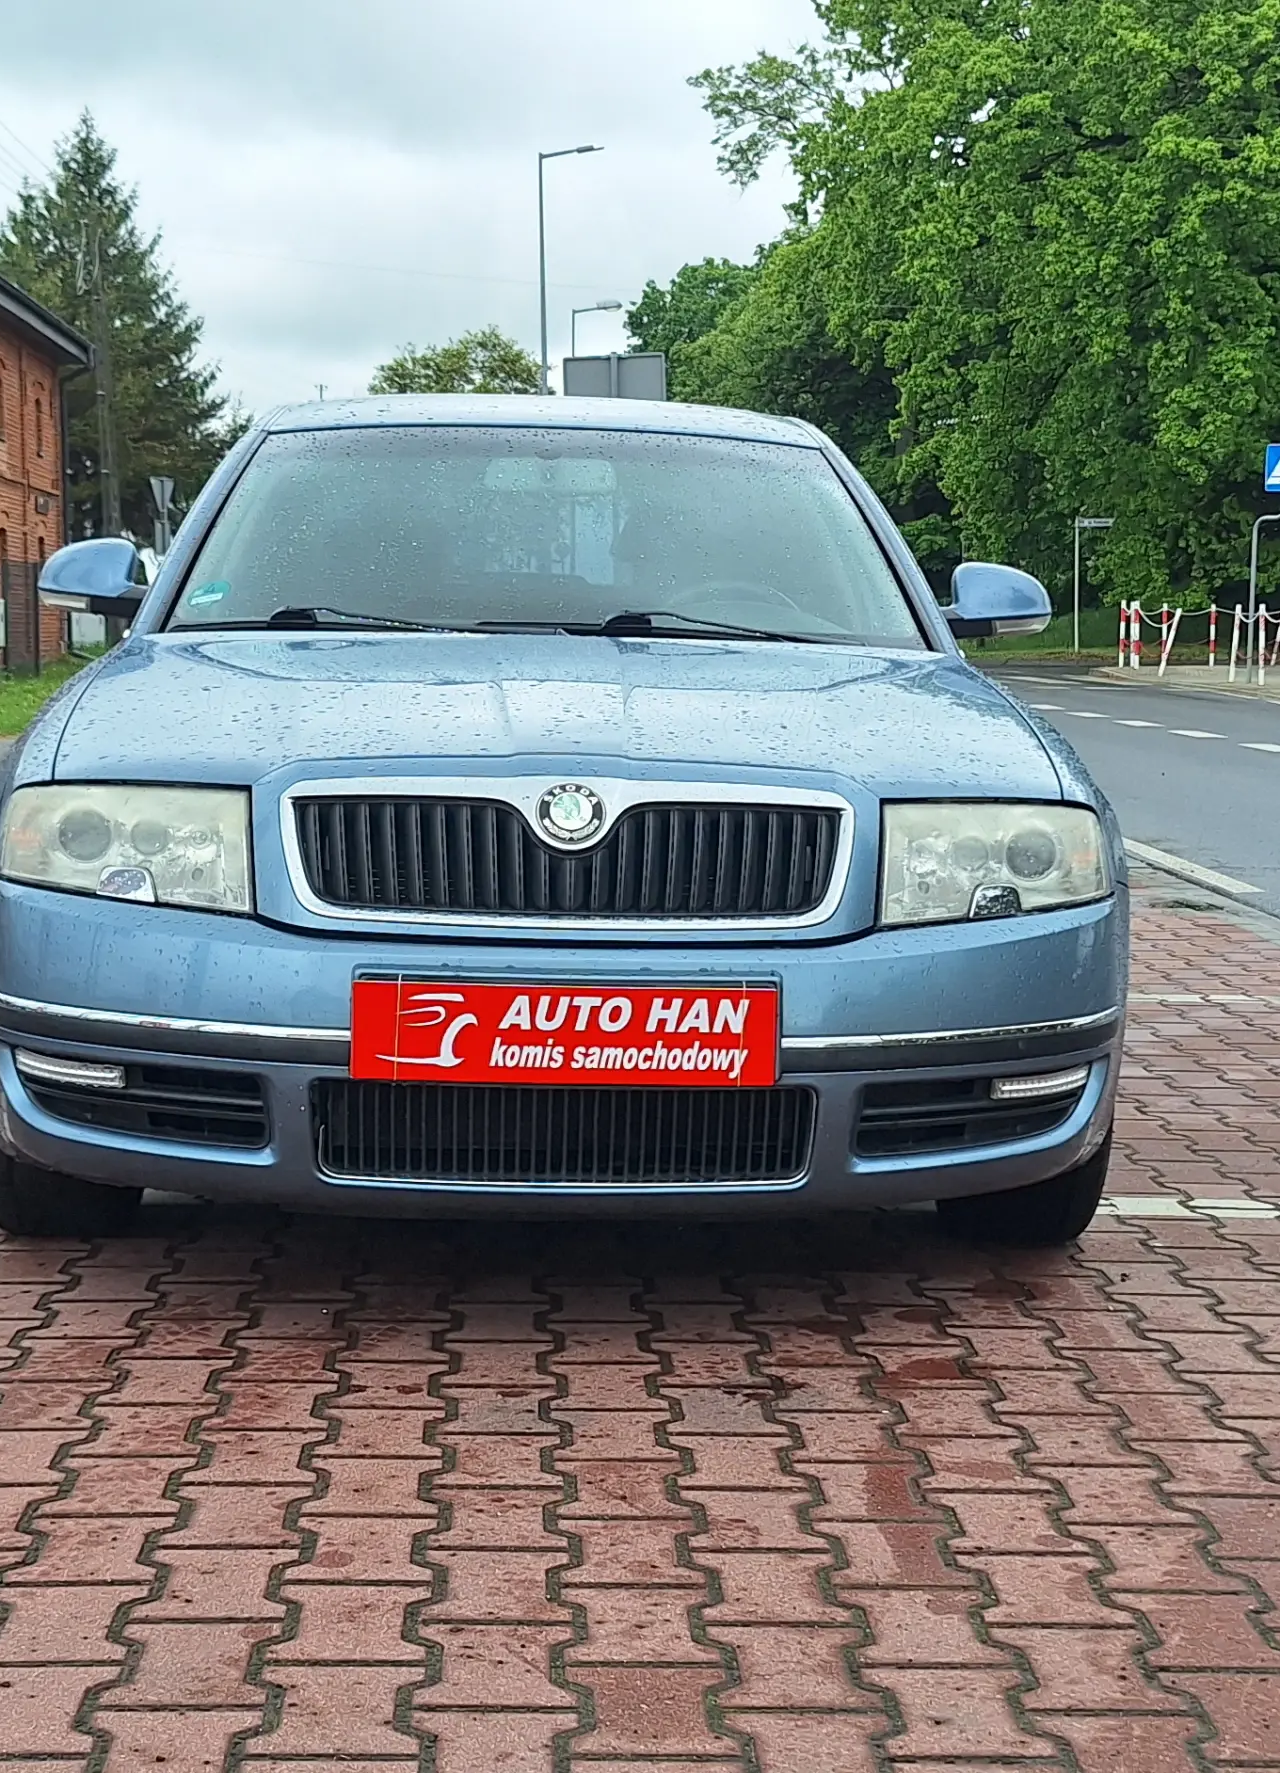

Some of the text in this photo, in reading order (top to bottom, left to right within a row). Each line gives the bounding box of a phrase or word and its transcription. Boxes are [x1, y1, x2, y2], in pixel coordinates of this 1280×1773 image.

[498, 995, 750, 1034] AUTO HAN
[489, 1036, 749, 1079] komis samochodowy
